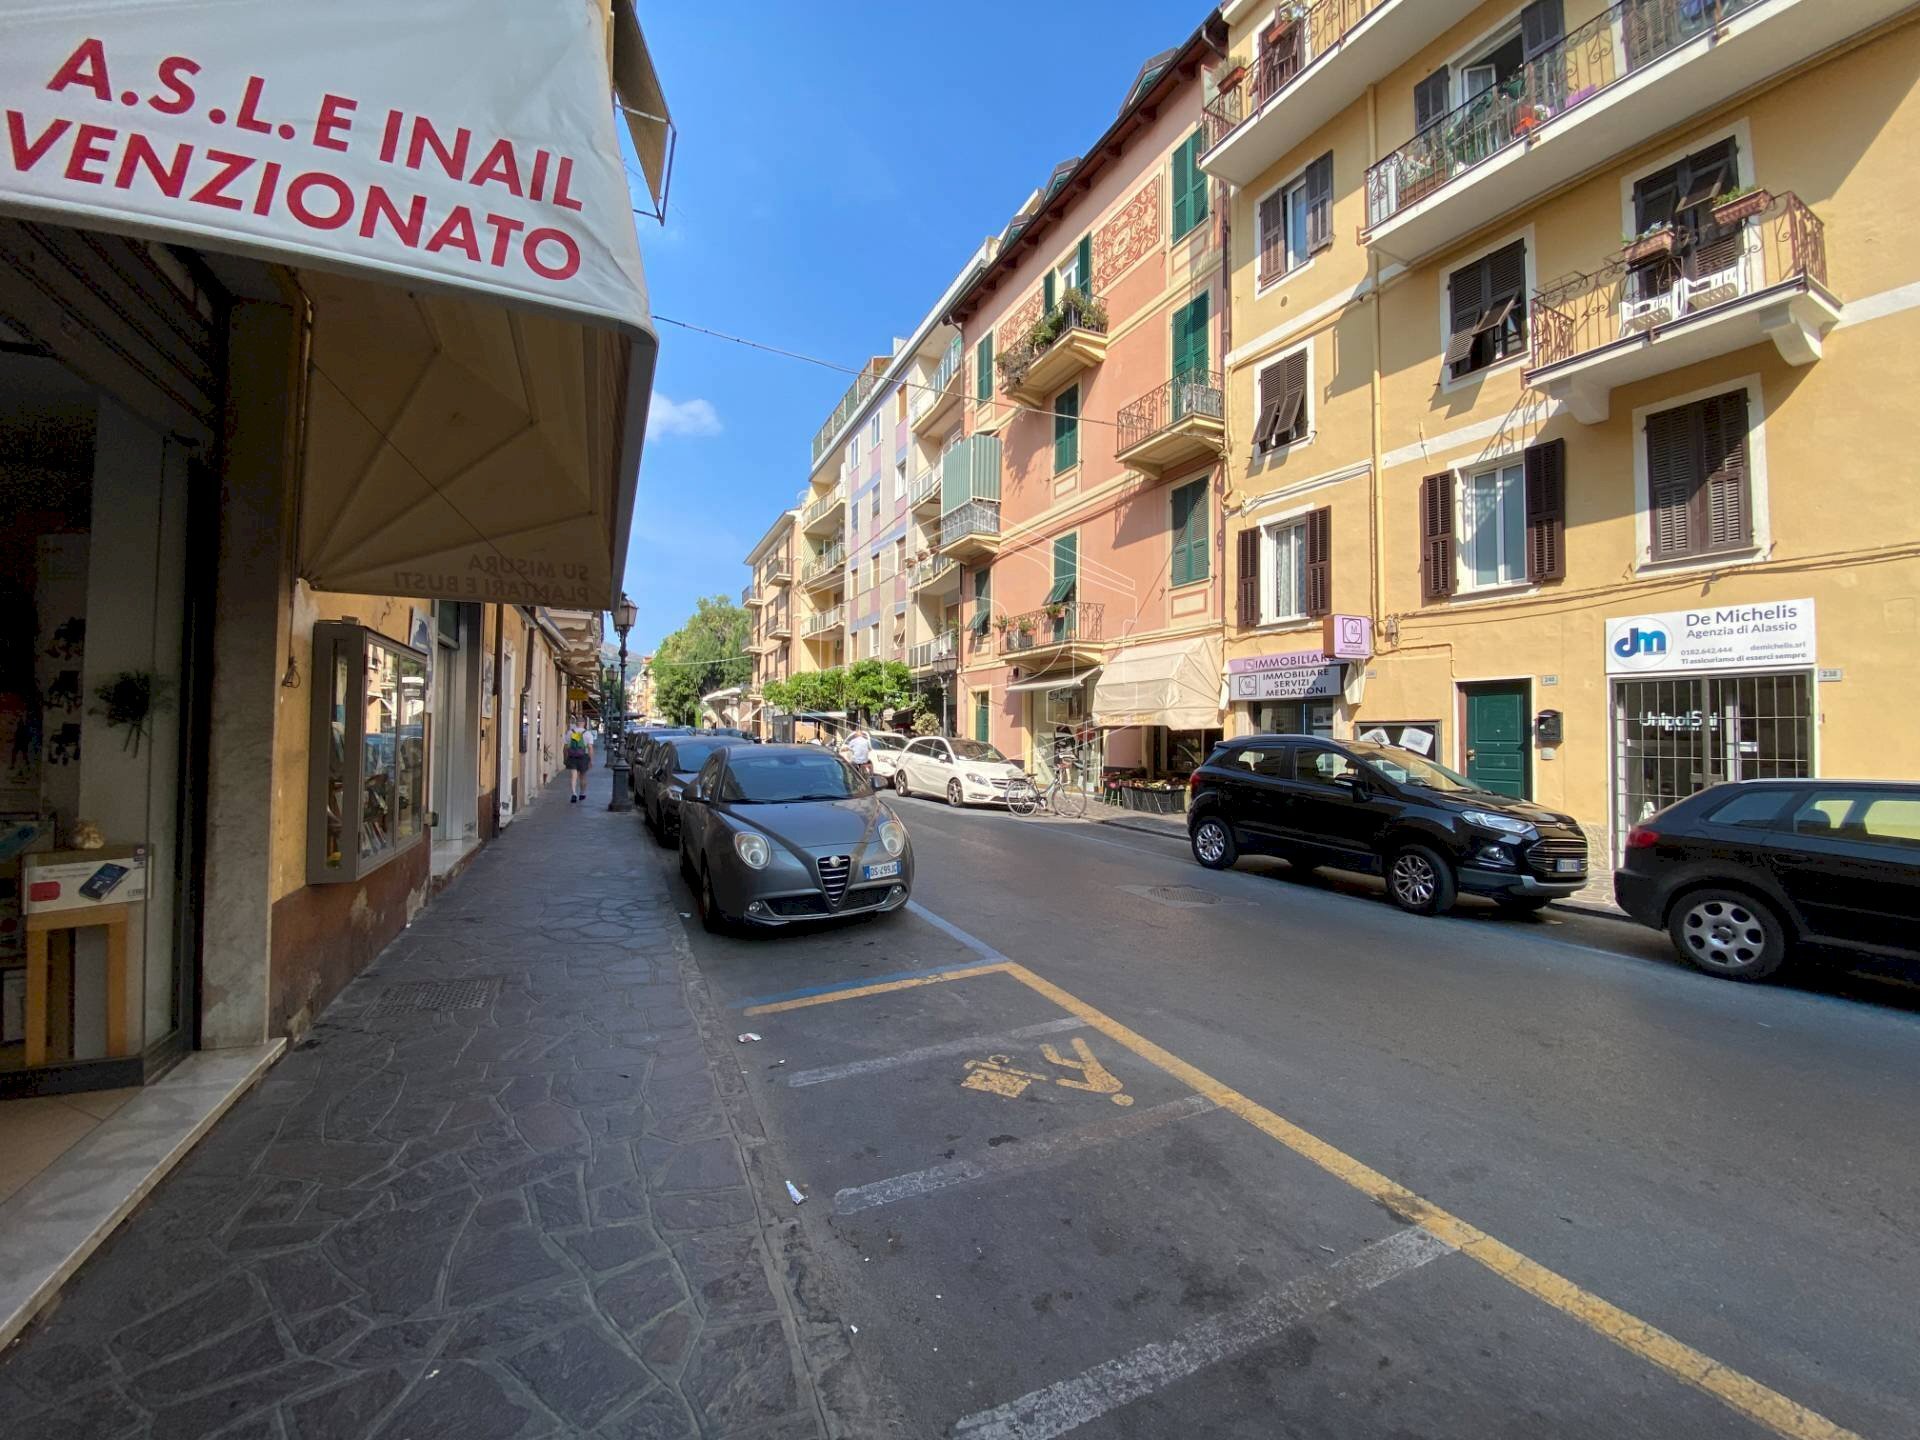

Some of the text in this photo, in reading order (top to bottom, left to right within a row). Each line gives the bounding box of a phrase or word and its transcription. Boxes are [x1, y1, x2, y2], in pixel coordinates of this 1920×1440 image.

[380, 110, 583, 211] INAIL
[6, 111, 581, 280] VENZIONATO
[1686, 605, 1798, 627] De Michelis
[1686, 622, 1798, 639] Agenzia di Alassio
[1255, 655, 1335, 669] IMMOBILIAR
[1681, 657, 1688, 665] Ti
[1690, 655, 1735, 665] assicuriamo
[1746, 653, 1773, 661] esserci
[1775, 652, 1807, 661] sempre
[1263, 669, 1329, 680] IMMOBILIARE
[1274, 679, 1310, 689] SERVIZI
[1265, 687, 1327, 697] MEDIAZIONI
